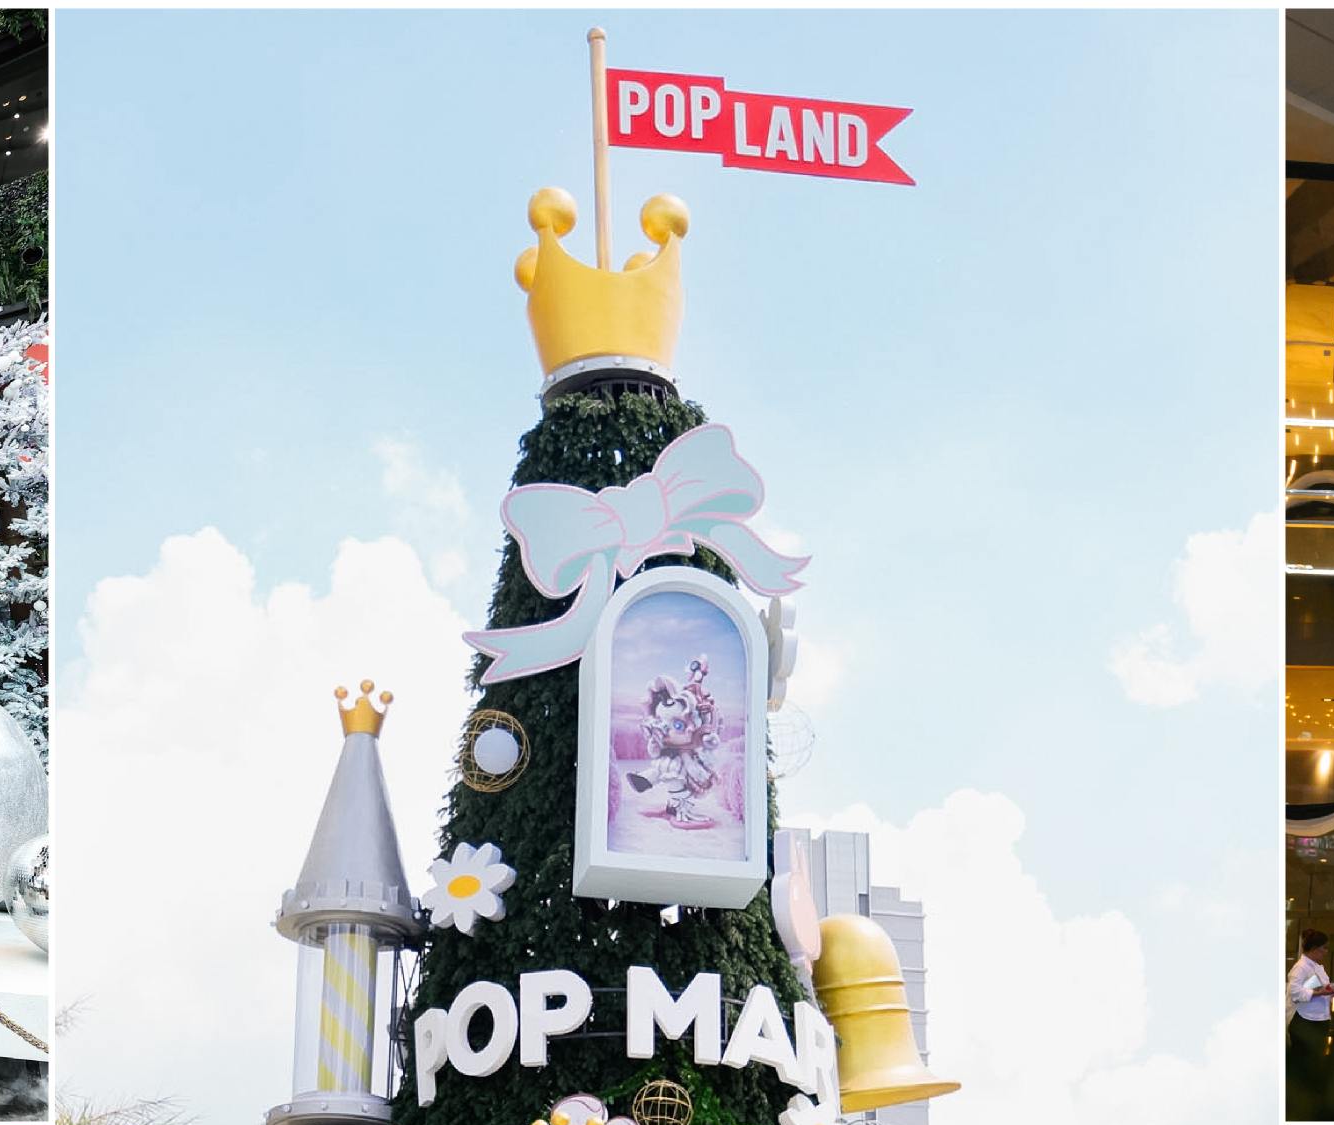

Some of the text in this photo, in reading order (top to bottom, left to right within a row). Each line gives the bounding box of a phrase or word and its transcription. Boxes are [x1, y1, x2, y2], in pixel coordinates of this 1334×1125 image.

[618, 80, 868, 168] POP LAND
[414, 964, 840, 1118] POP MAR
